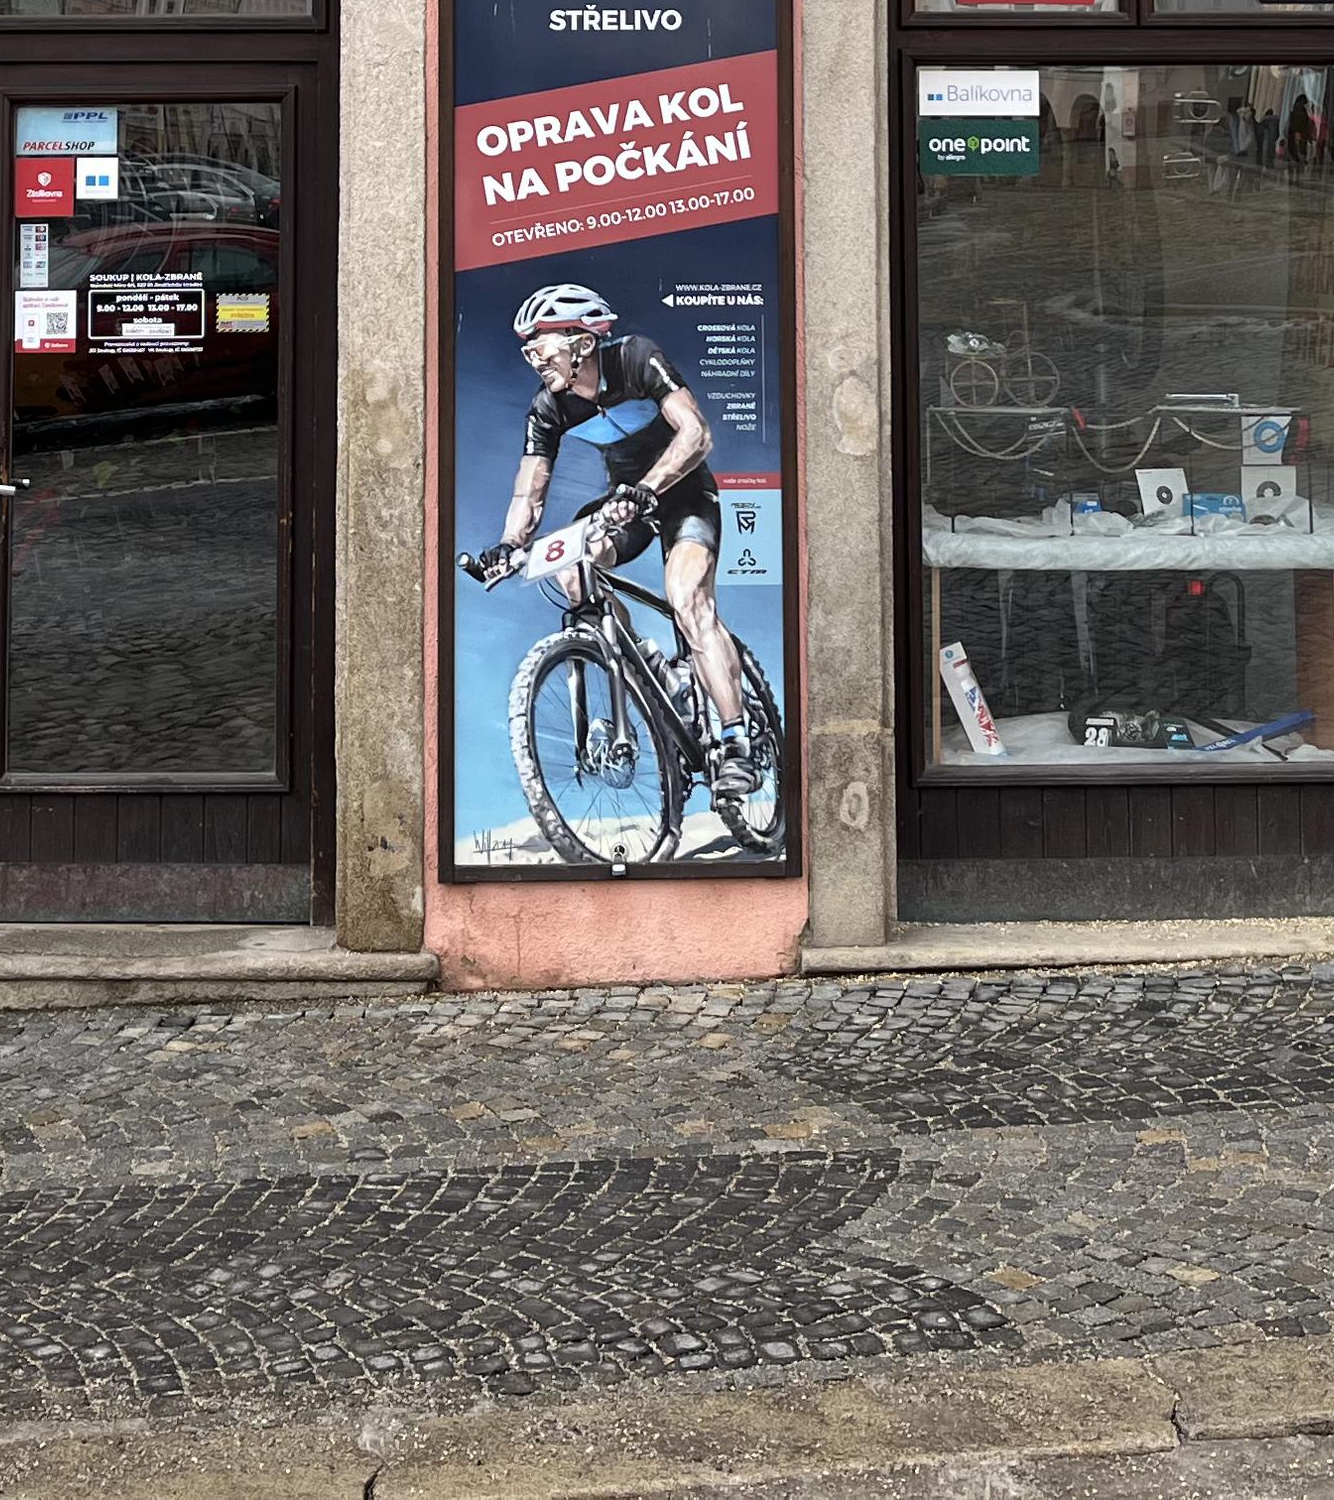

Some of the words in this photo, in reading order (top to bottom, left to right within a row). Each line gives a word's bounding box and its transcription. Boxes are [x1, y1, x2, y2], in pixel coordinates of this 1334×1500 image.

[549, 4, 683, 31] STŘELIVO
[946, 84, 1032, 102] Balíkovna
[72, 111, 108, 120] PPL
[476, 99, 654, 156] OPRAVA
[658, 83, 744, 125] KOL
[22, 141, 95, 151] PARCELSHOP
[928, 138, 966, 152] one
[980, 135, 1031, 155] point
[482, 167, 550, 206] NA
[554, 120, 752, 192] POČKÁNÍ
[491, 220, 585, 247] OTEVŘENO:
[586, 202, 667, 229] 9.00-12.00
[668, 186, 755, 214] 13.00-17.00
[89, 273, 130, 282] SOUKUP
[135, 271, 203, 282] KOLA-ZBRANĚ
[675, 284, 762, 292] WWW.KOLA-ZBRANE.CZ
[116, 293, 149, 303] pondělí
[154, 293, 180, 303] pátek
[675, 293, 725, 306] KOUPÍTE
[726, 295, 736, 306] U
[736, 293, 765, 306] NÁS:
[96, 304, 116, 313] 9.00
[122, 304, 144, 312] 12.00
[176, 303, 198, 312] 17.00
[133, 315, 163, 324] sobota
[545, 539, 565, 562] 8
